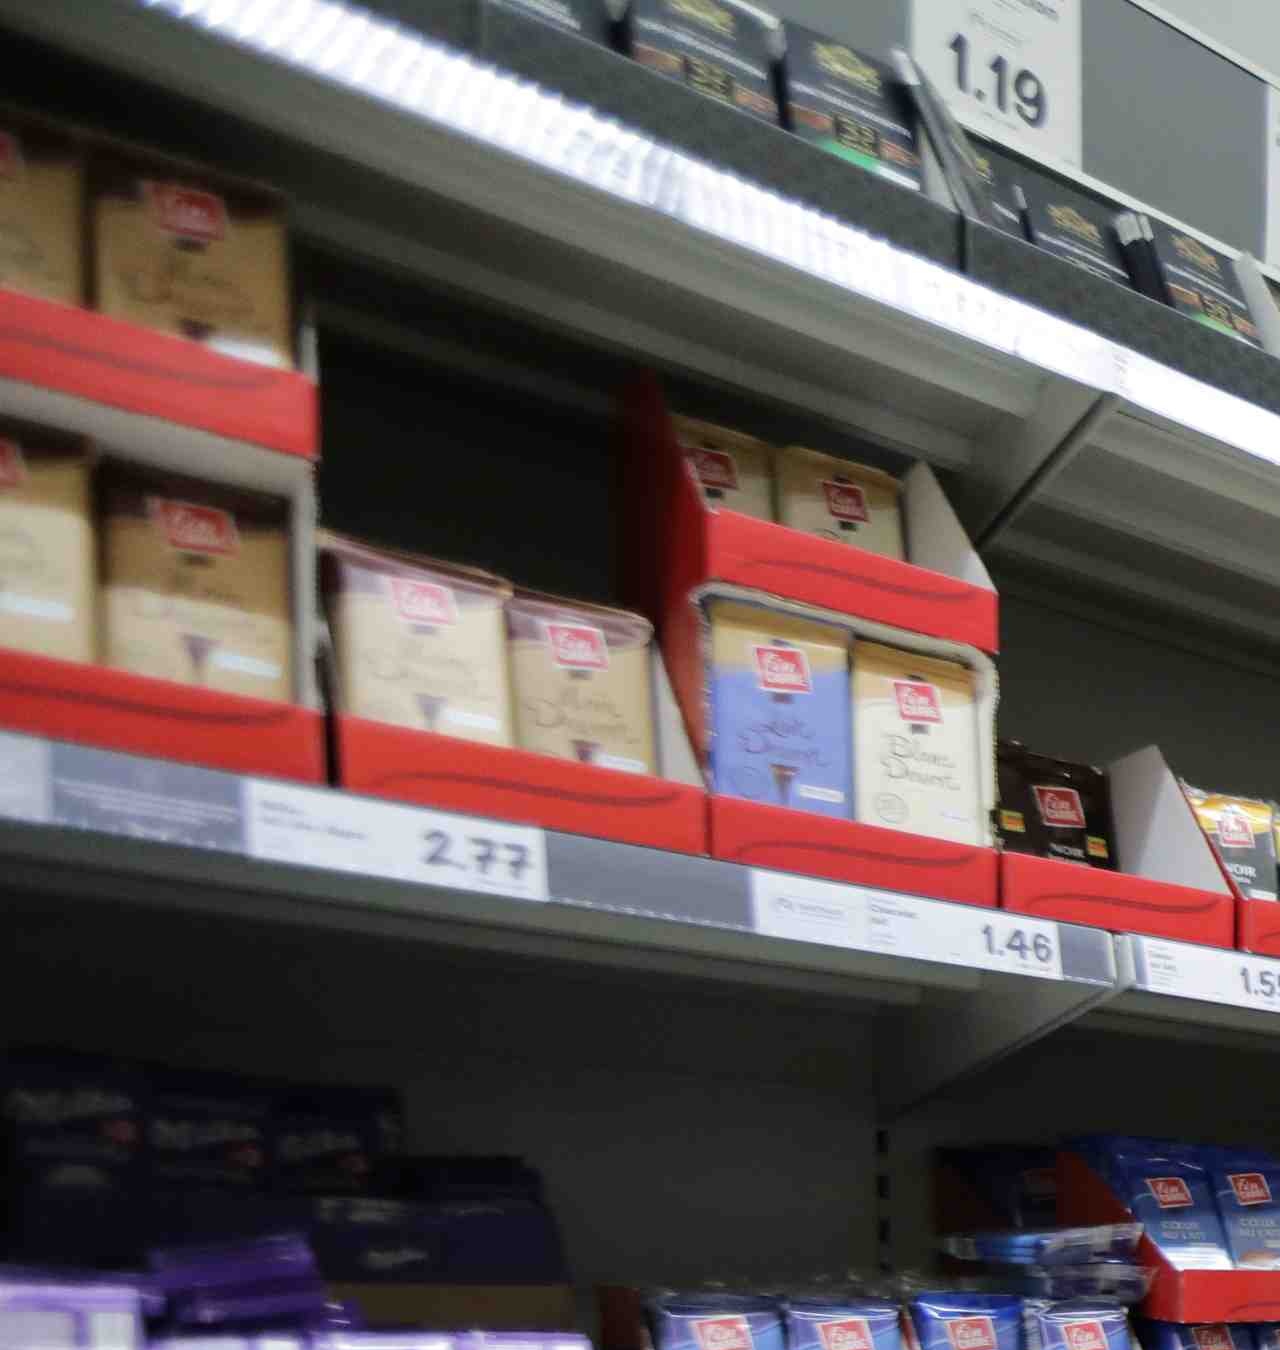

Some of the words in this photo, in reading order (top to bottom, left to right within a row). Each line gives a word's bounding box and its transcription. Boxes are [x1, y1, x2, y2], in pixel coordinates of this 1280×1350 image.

[950, 33, 1047, 128] 1.19
[423, 829, 530, 879] 2.77
[981, 923, 1051, 963] 1.46
